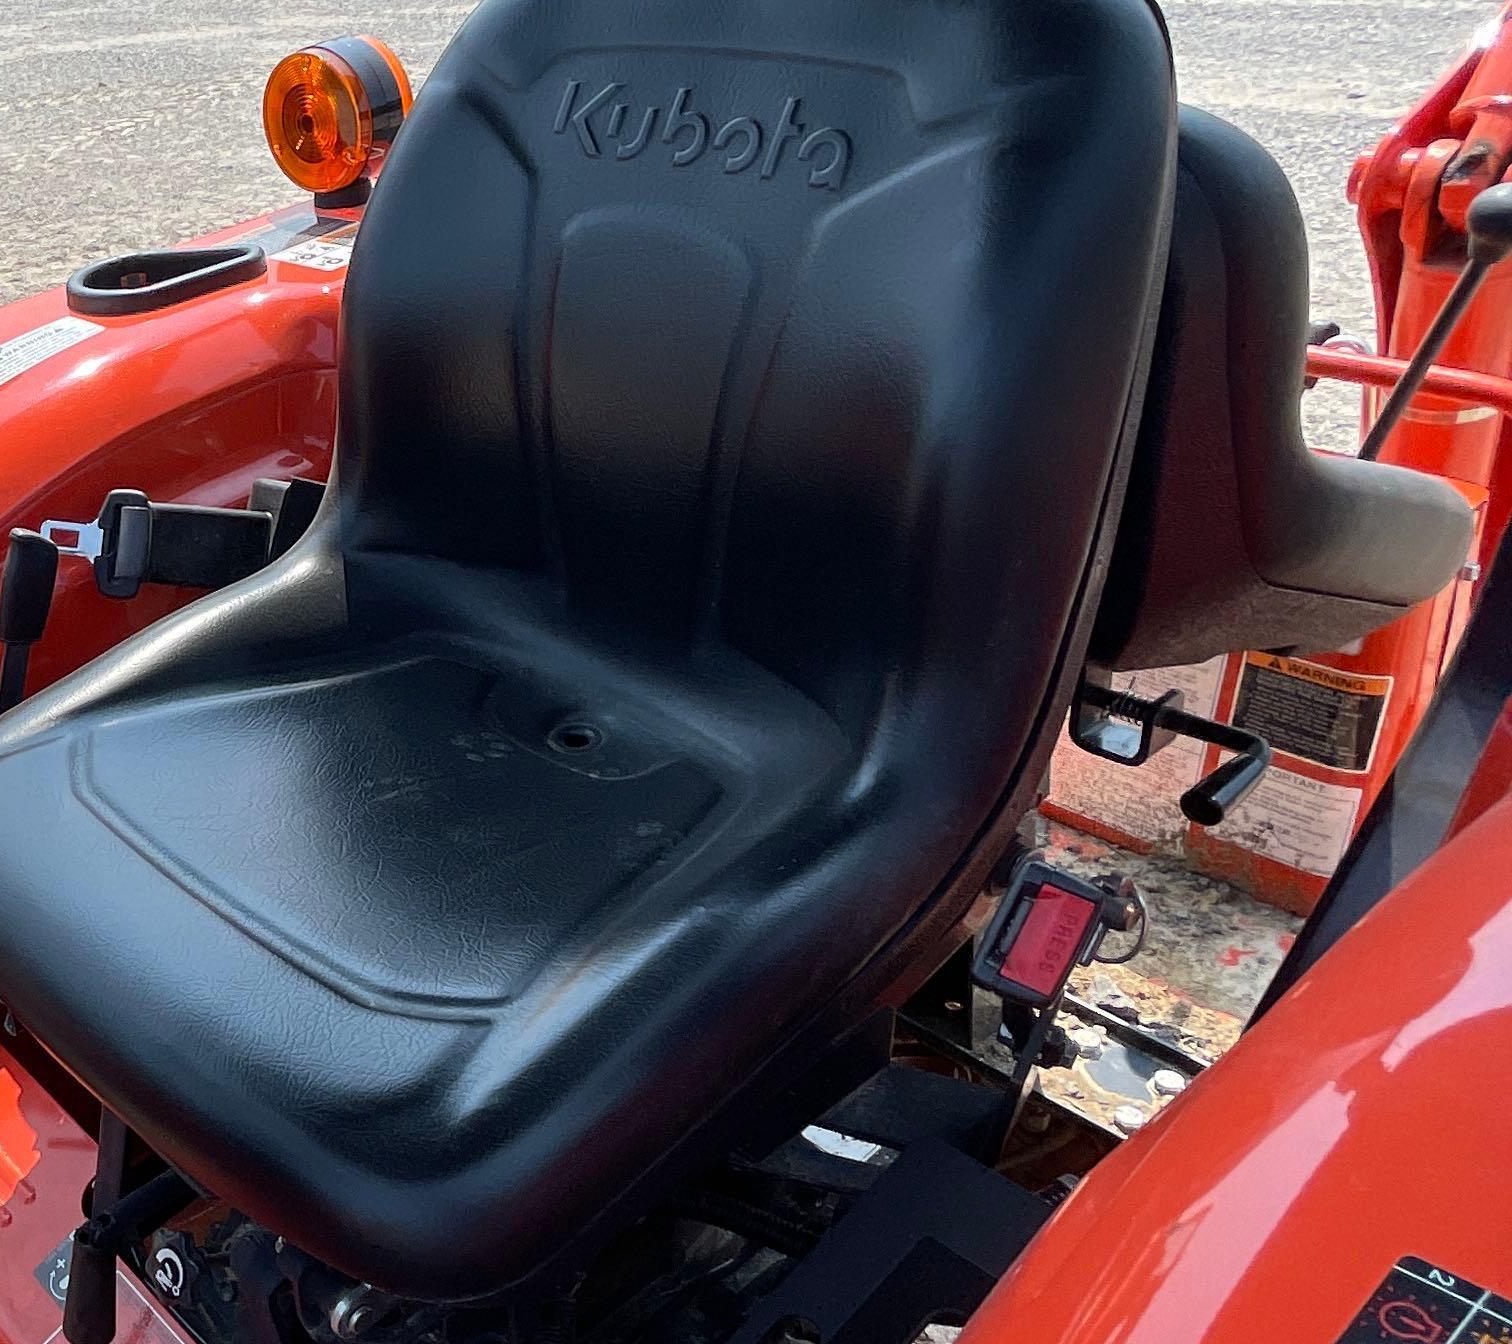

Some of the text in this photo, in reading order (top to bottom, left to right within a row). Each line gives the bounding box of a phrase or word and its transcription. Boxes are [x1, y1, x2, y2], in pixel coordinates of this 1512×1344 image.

[553, 79, 854, 191] Kubota
[1285, 662, 1367, 691] WARNING
[1428, 1269, 1455, 1288] 2
